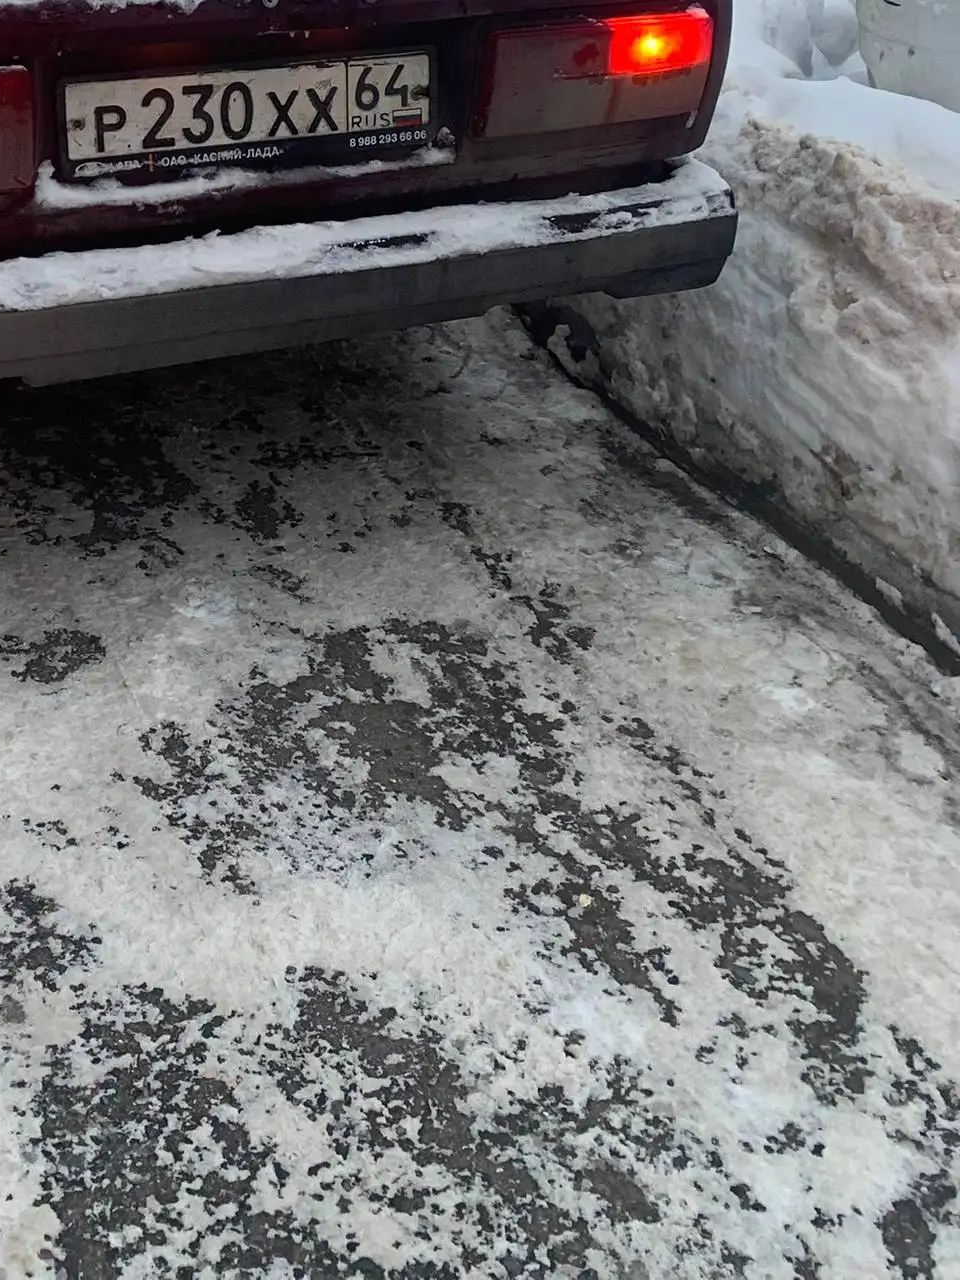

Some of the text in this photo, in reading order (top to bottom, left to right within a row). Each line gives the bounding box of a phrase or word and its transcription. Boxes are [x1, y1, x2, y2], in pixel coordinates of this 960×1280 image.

[355, 64, 410, 111] 64
[351, 112, 390, 129] RUS
[349, 129, 427, 148] 8 988 293 66 06
[160, 155, 186, 167] ОАО
